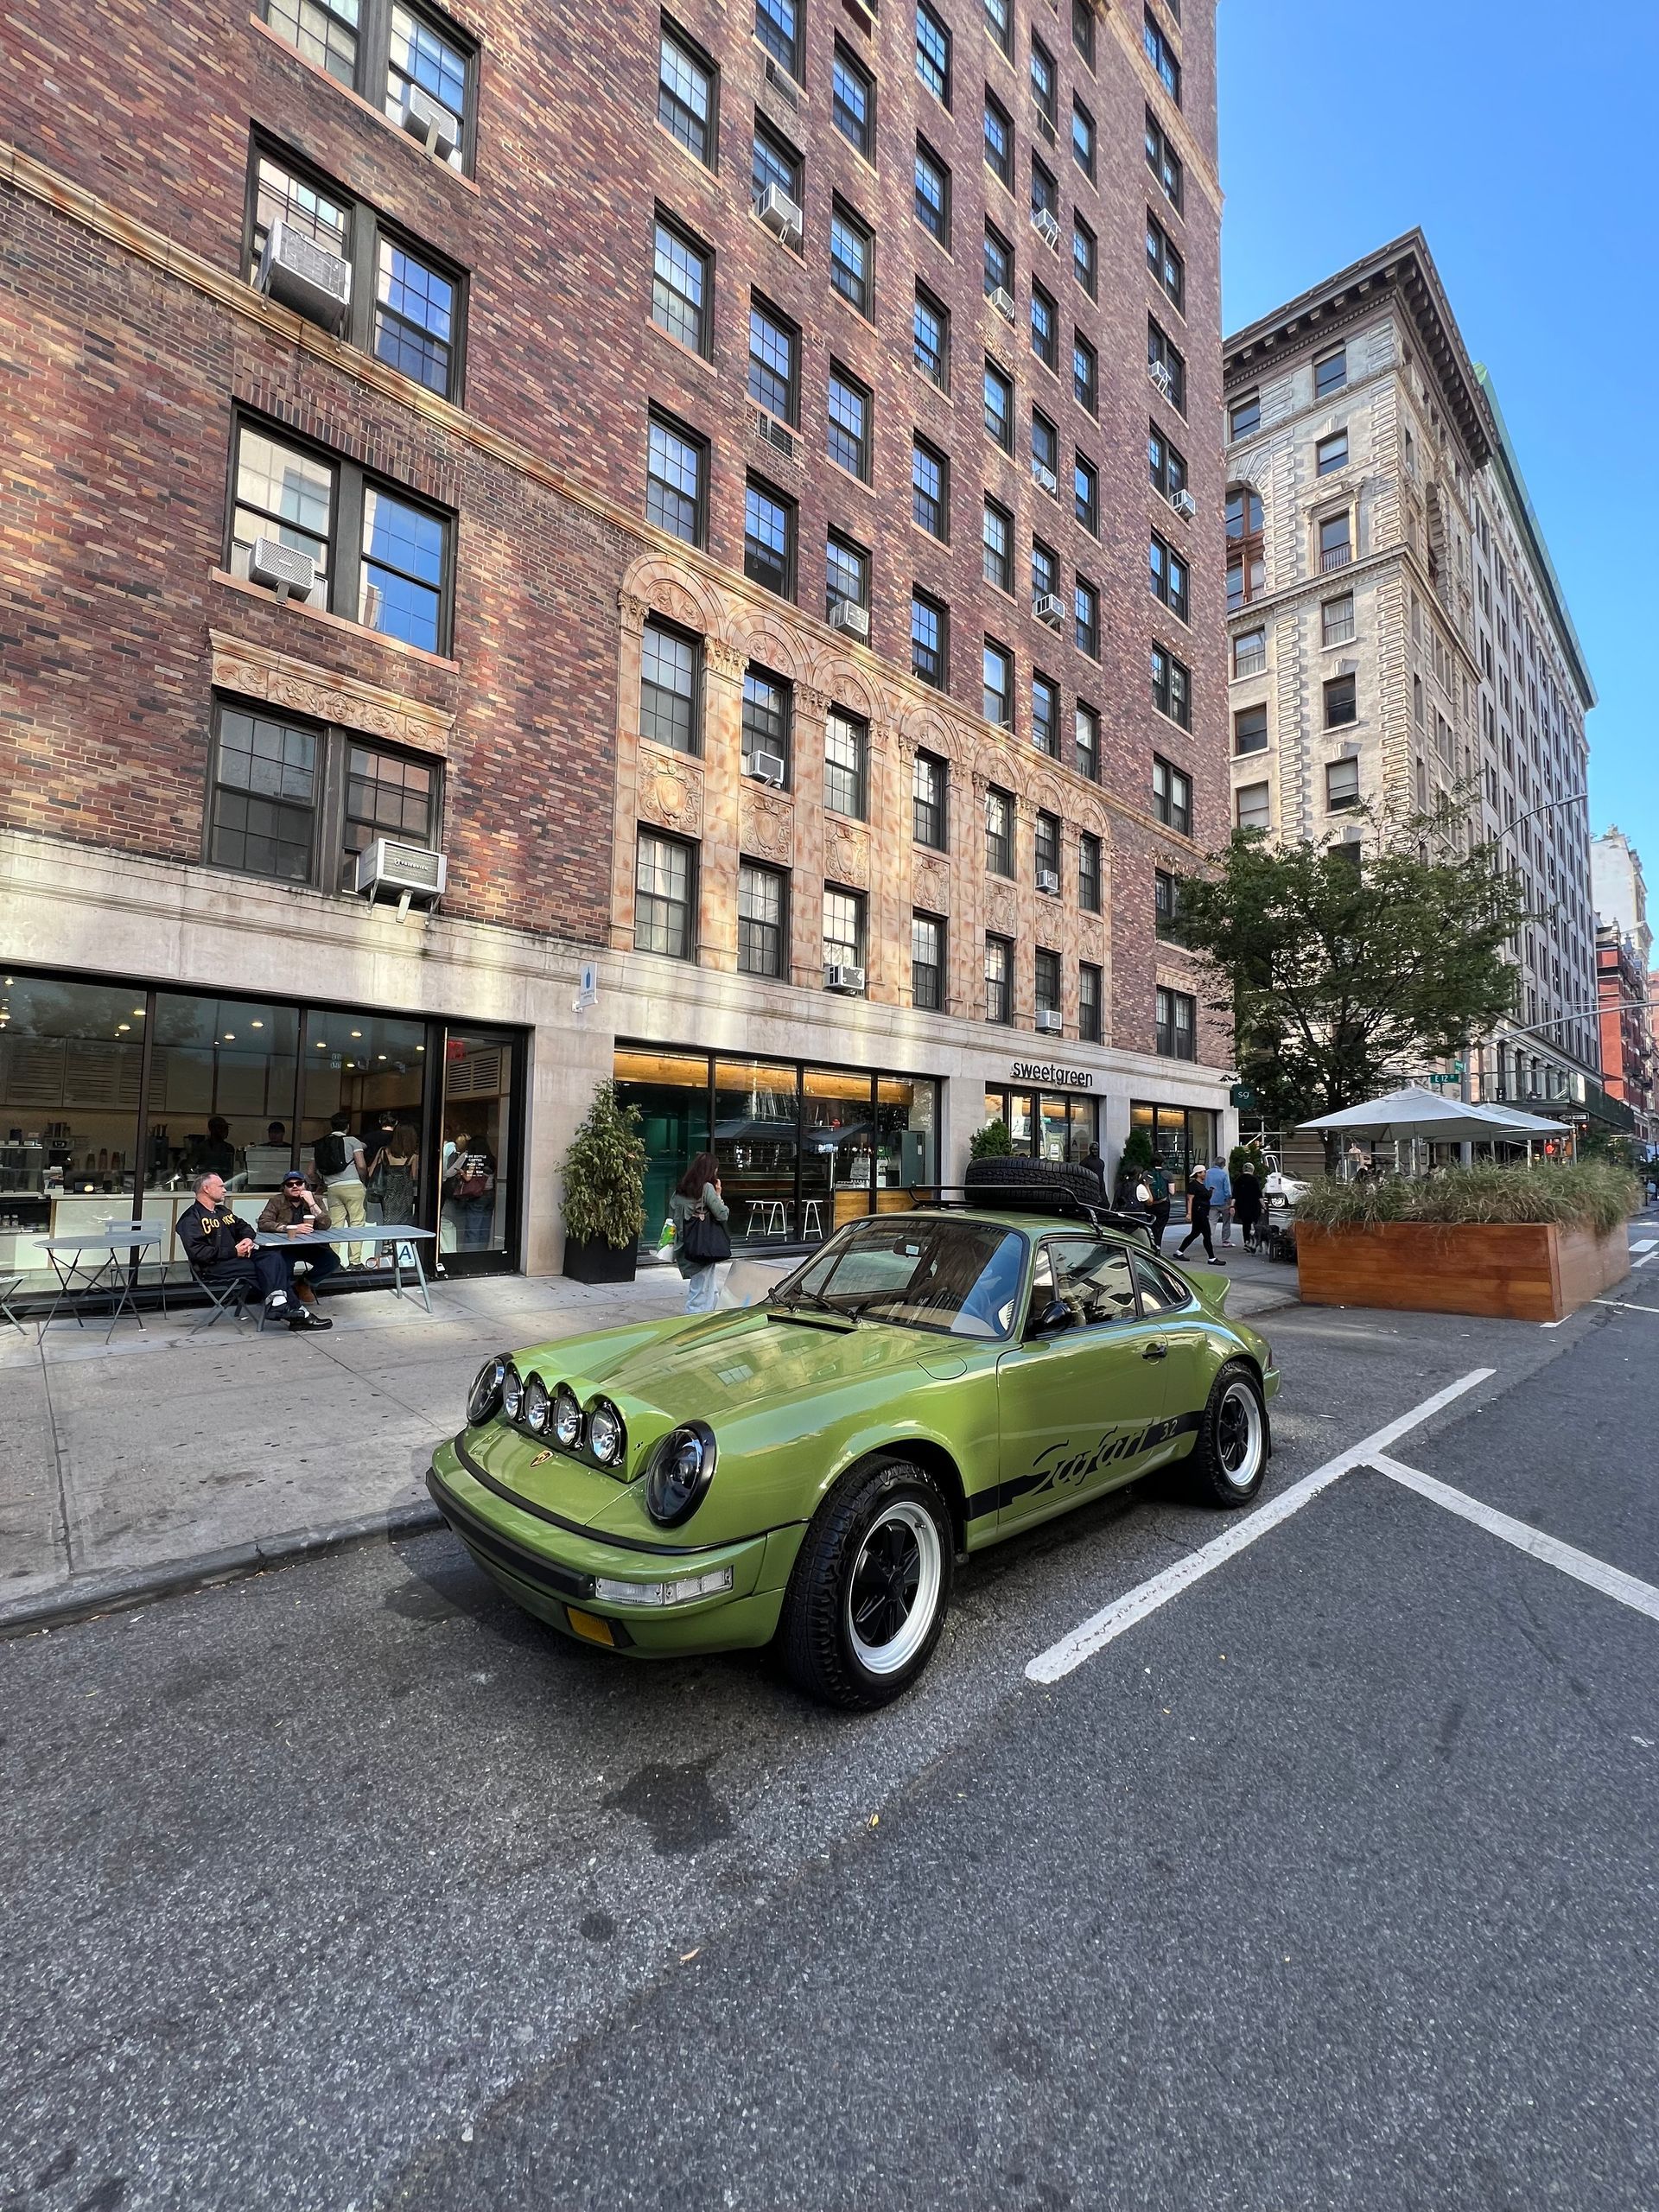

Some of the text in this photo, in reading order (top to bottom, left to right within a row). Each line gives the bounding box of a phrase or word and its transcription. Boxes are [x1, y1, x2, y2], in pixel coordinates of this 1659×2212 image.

[1012, 1062, 1093, 1088] sweetgreen
[1237, 1091, 1249, 1100] sg
[397, 1244, 412, 1261] A
[1031, 1415, 1154, 1488] Safari
